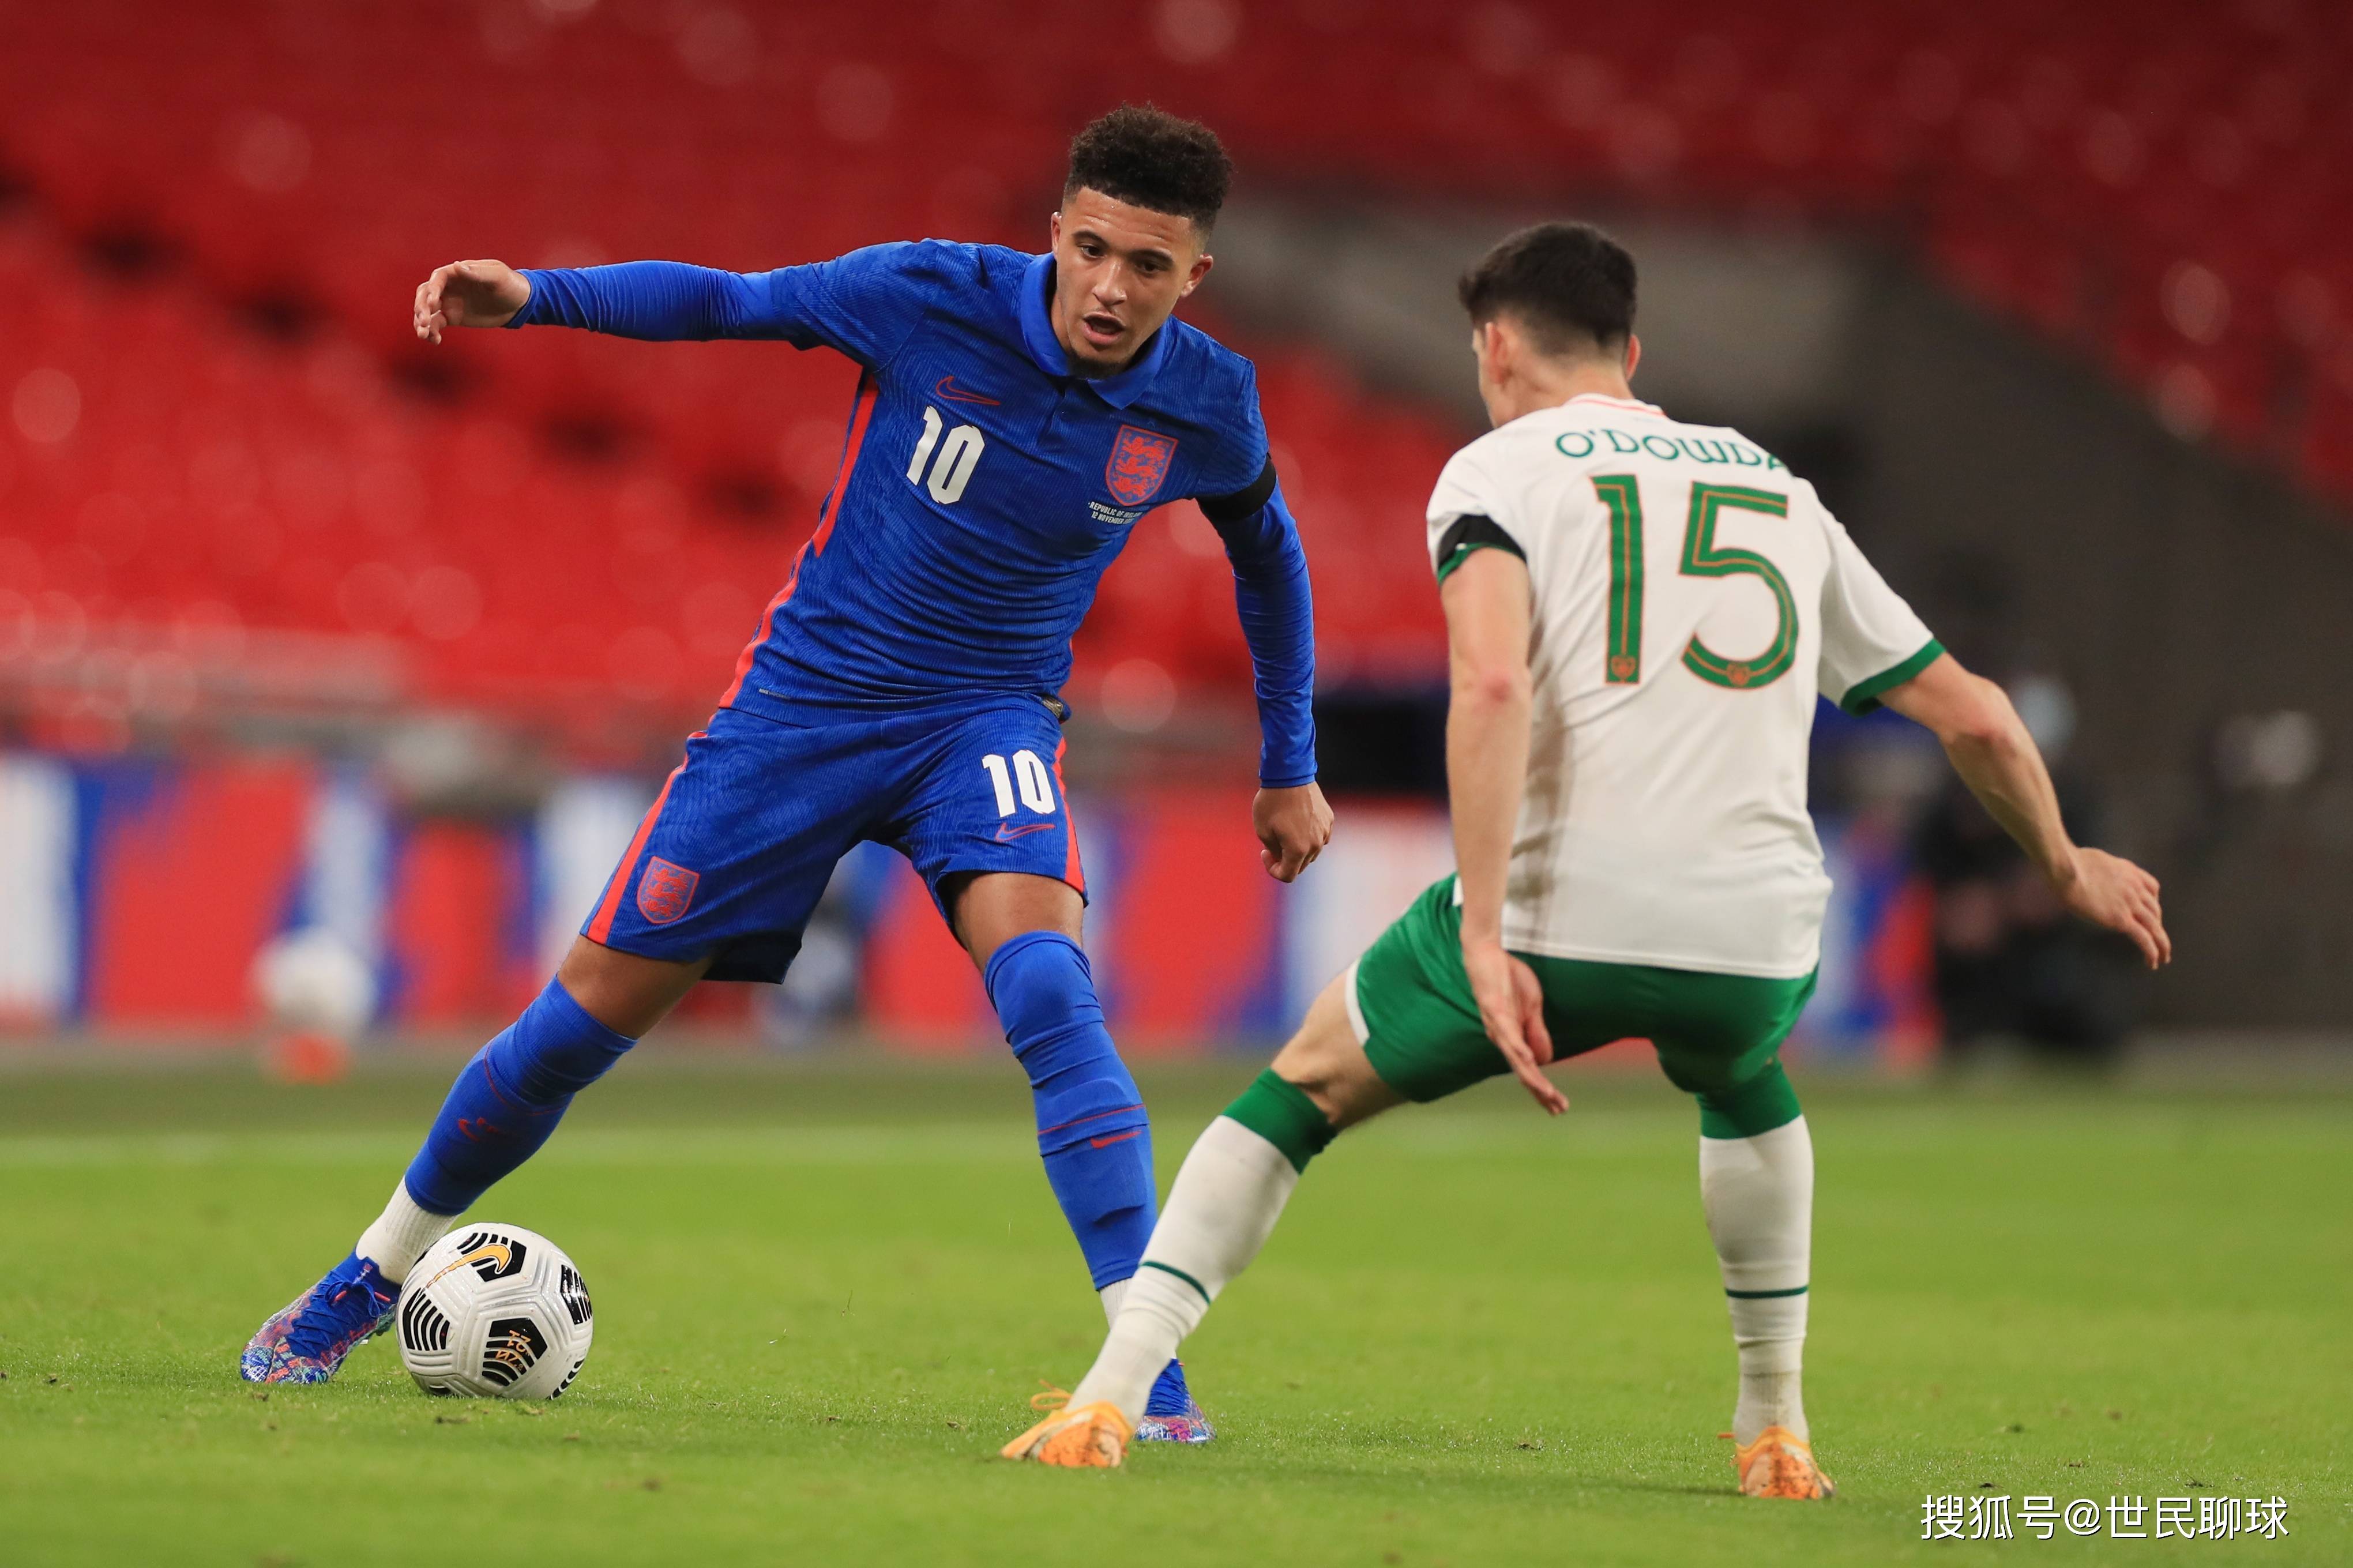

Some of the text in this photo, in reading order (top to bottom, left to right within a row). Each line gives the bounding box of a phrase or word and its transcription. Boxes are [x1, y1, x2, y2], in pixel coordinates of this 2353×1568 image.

[906, 405, 985, 505] 10
[1089, 501, 1117, 516] REPUBLIC
[1091, 511, 1099, 519] 12
[1589, 474, 1799, 690] 15
[982, 749, 1056, 818] 10
